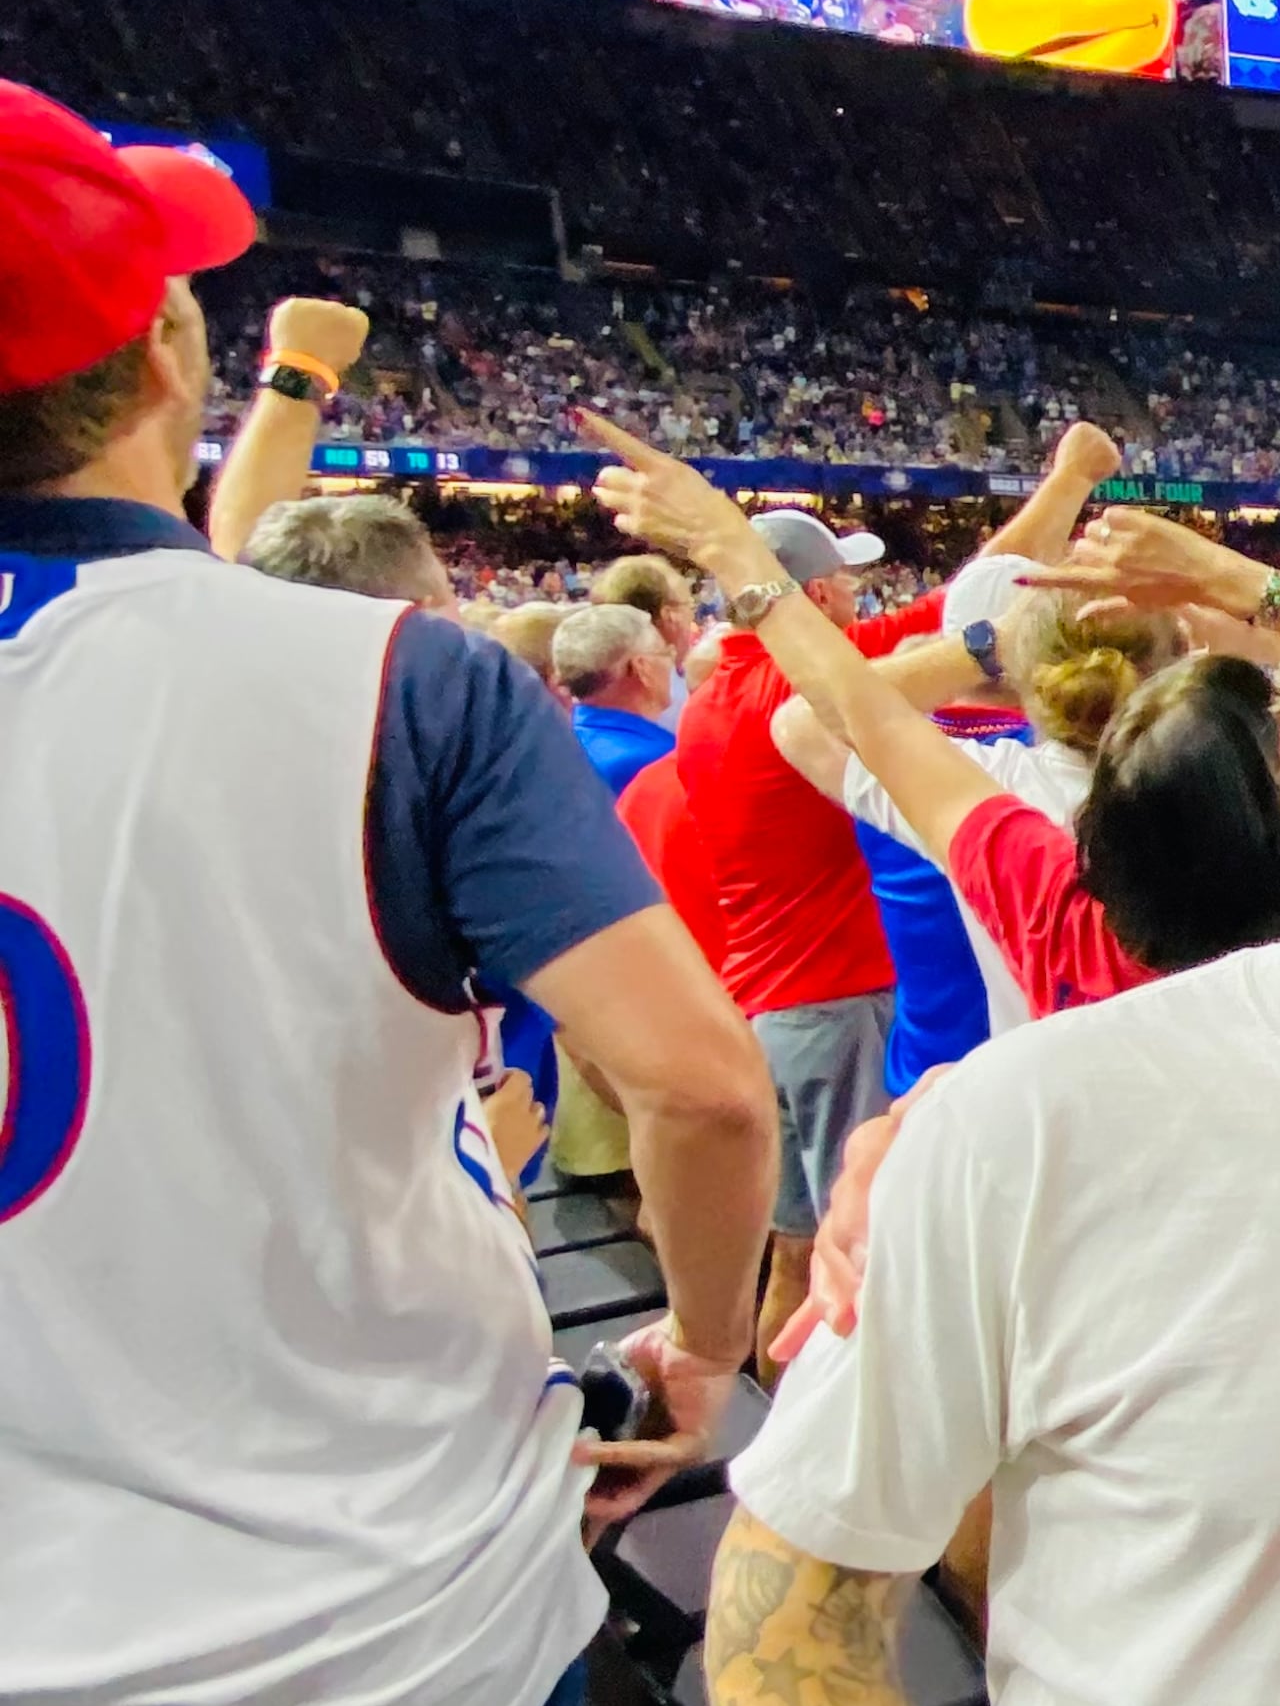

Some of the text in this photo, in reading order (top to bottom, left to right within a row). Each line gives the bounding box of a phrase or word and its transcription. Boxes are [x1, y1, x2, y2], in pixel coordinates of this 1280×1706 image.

[436, 451, 460, 471] 13
[1092, 477, 1204, 506] FINAL FOUR
